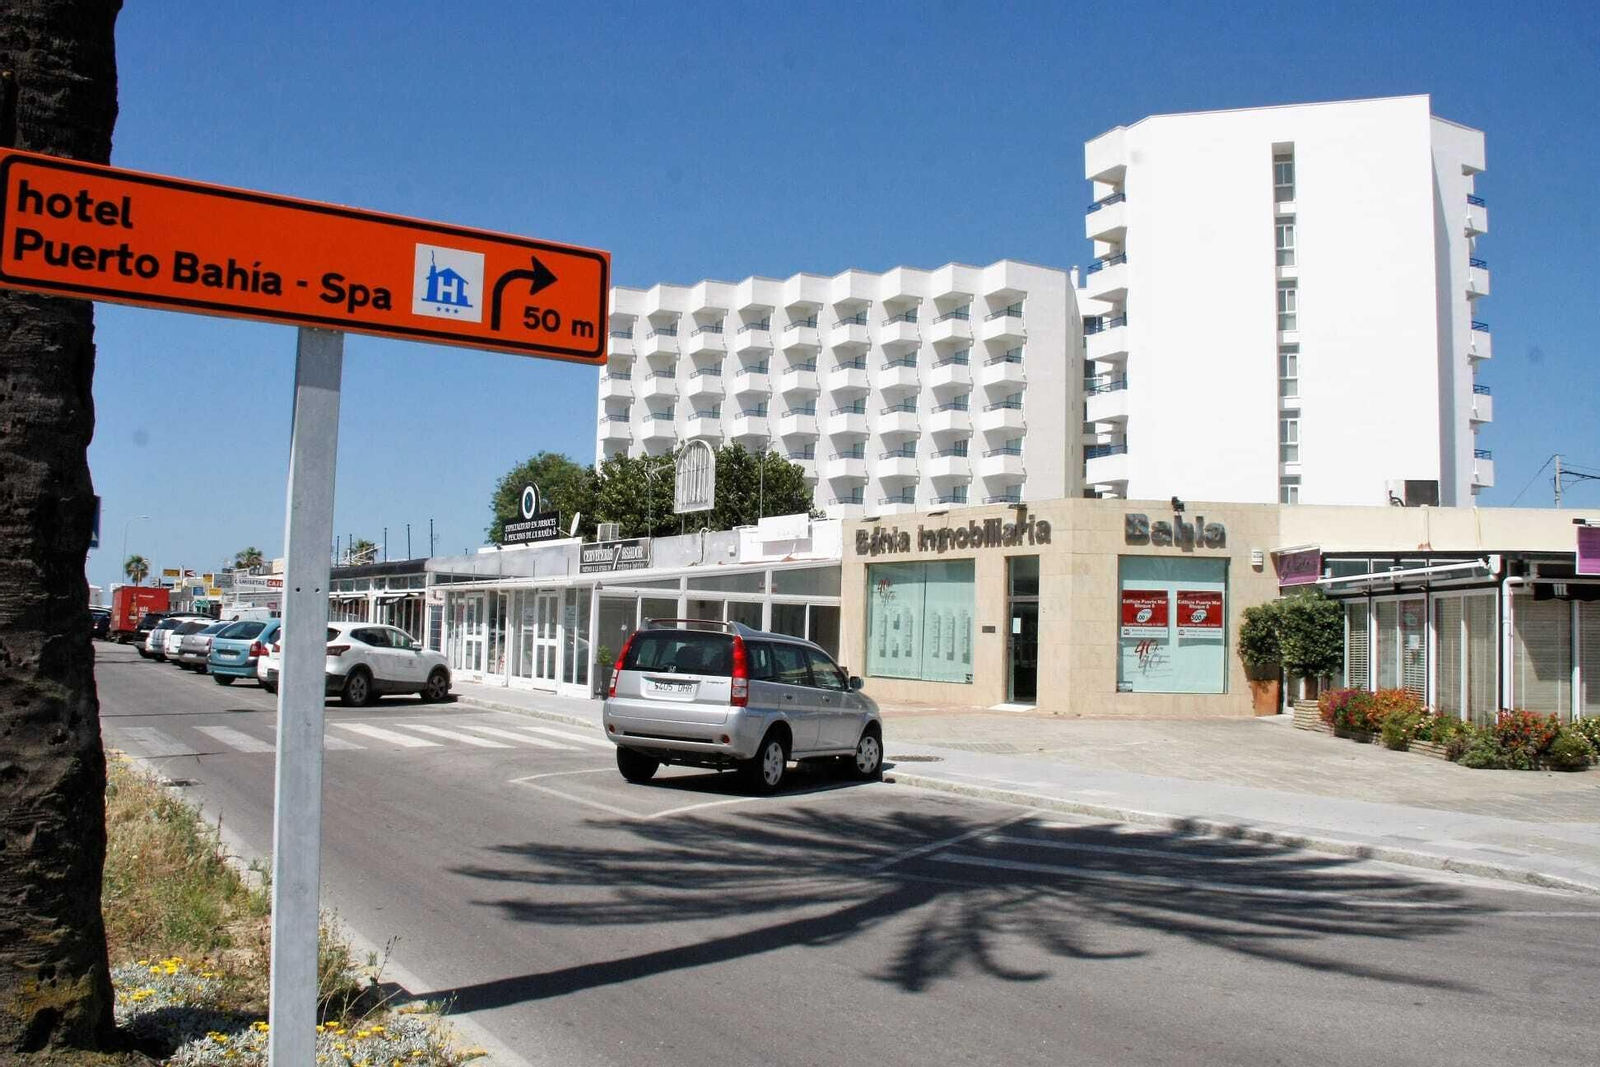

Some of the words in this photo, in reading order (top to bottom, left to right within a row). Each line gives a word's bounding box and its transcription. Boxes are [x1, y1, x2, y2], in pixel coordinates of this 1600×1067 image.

[17, 179, 133, 229] hotel
[13, 227, 160, 279] Puerto
[172, 250, 282, 296] Bahía
[296, 279, 308, 288] -
[319, 272, 392, 314] Spa
[523, 306, 561, 333] 50
[571, 318, 594, 339] m
